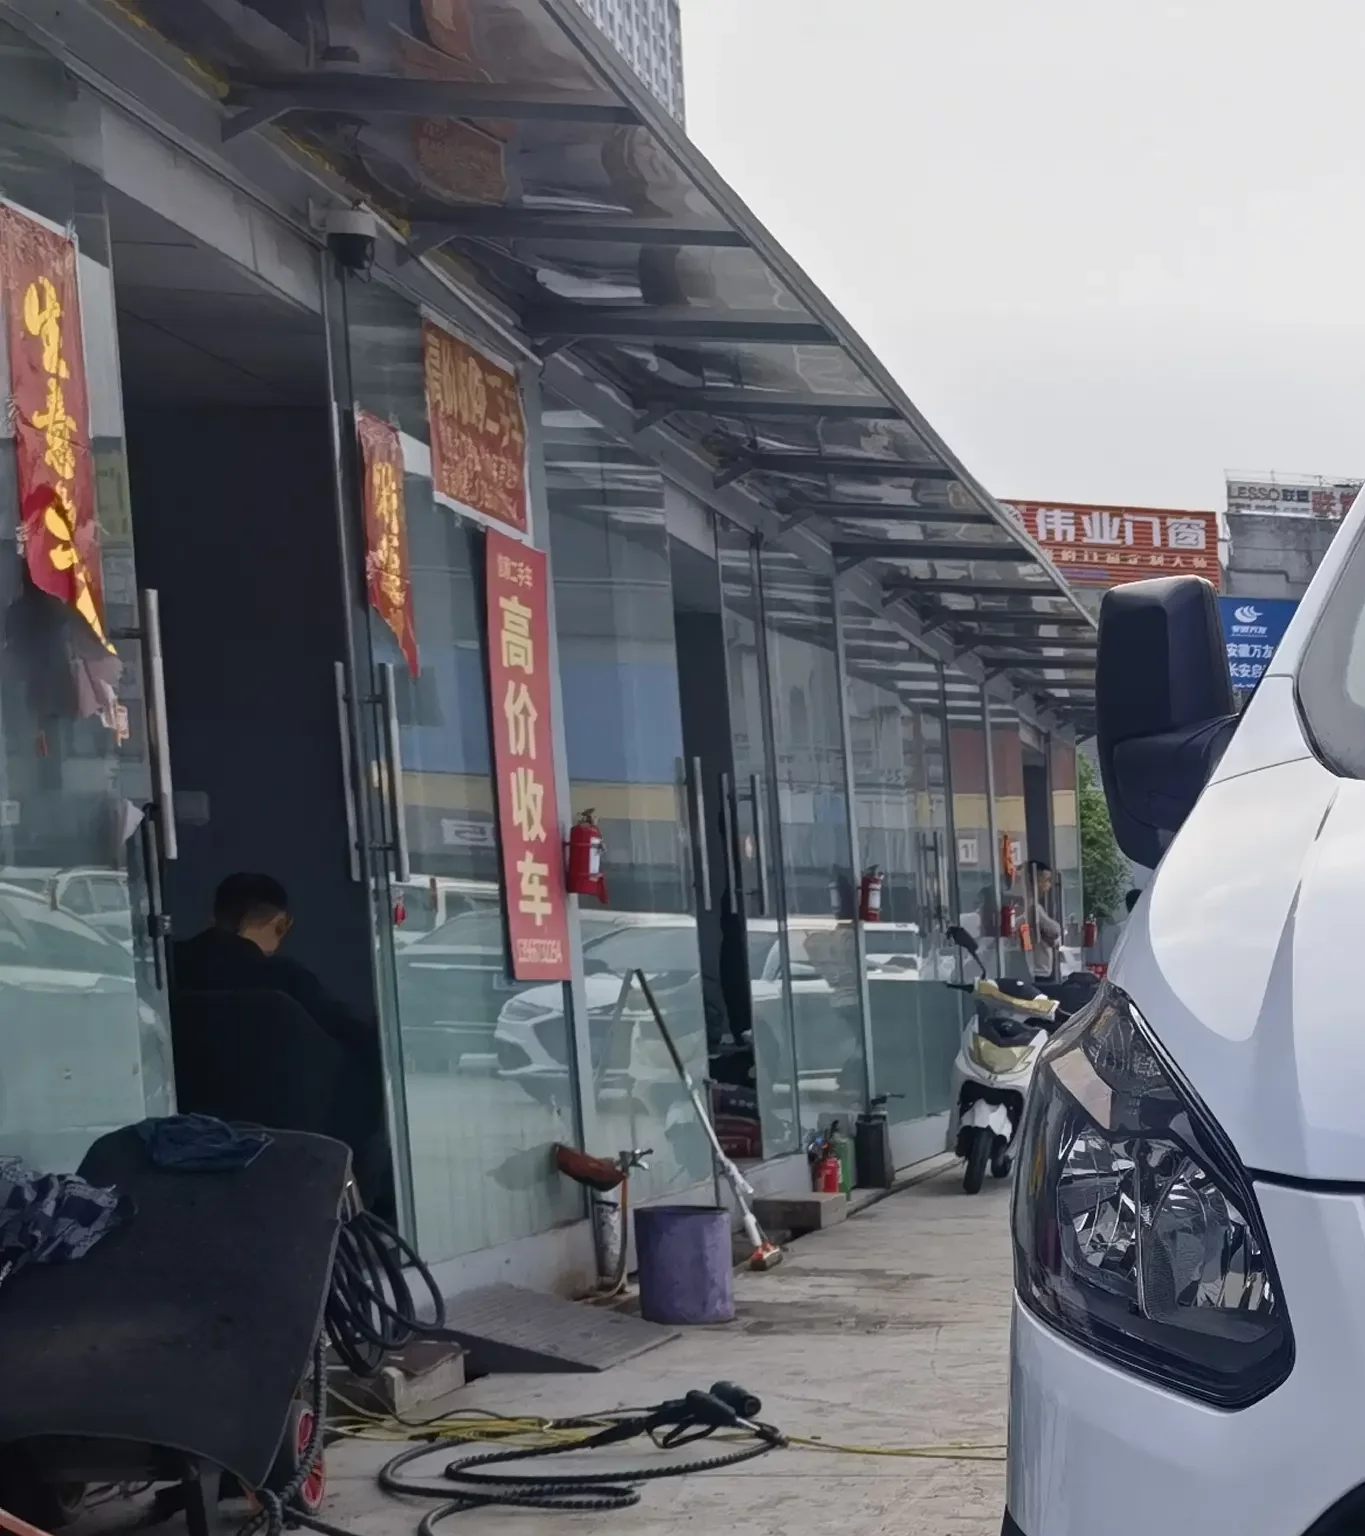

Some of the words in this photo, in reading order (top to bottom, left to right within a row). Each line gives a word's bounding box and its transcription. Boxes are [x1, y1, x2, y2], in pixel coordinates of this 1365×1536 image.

[1036, 507, 1207, 550] 伟业门窗
[498, 595, 553, 927] 高价收车
